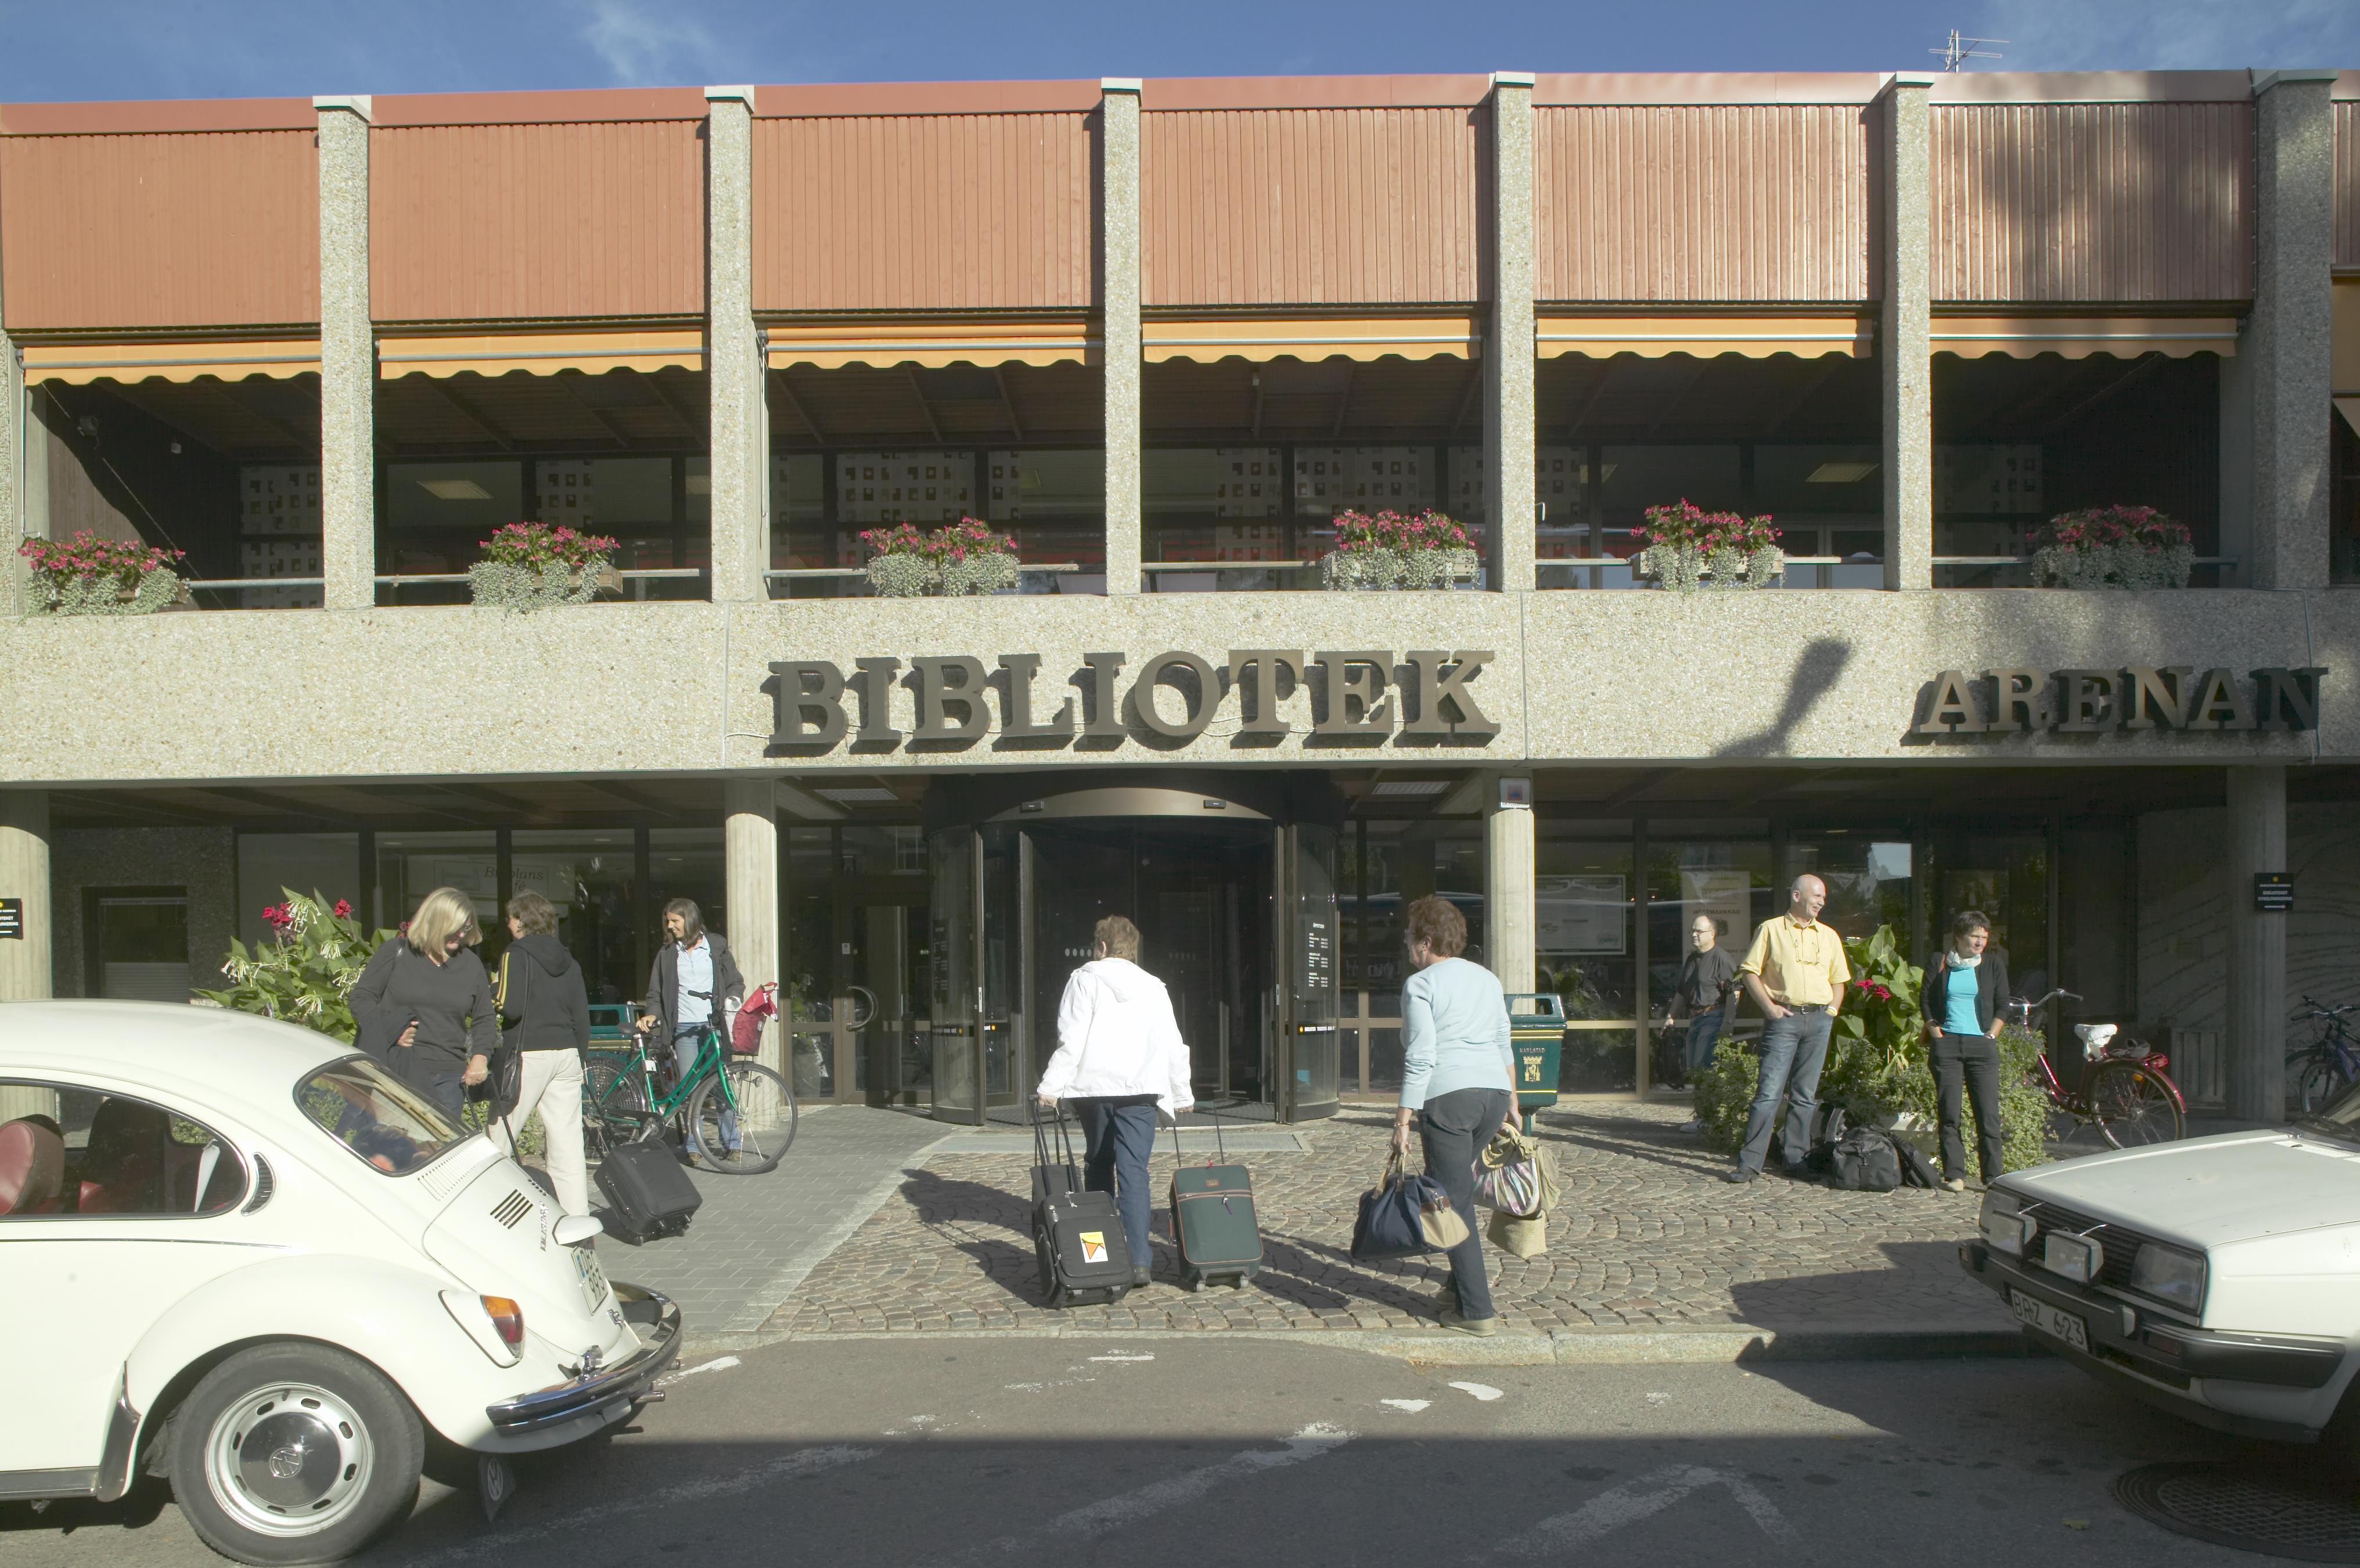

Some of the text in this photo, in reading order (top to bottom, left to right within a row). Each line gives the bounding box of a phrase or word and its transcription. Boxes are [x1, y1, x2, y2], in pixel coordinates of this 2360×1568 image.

[767, 649, 1502, 746] BIBLIOTEK
[1919, 665, 2329, 733] ARENAN
[588, 1266, 605, 1301] 993
[2013, 1293, 2084, 1346] BRZ 623
